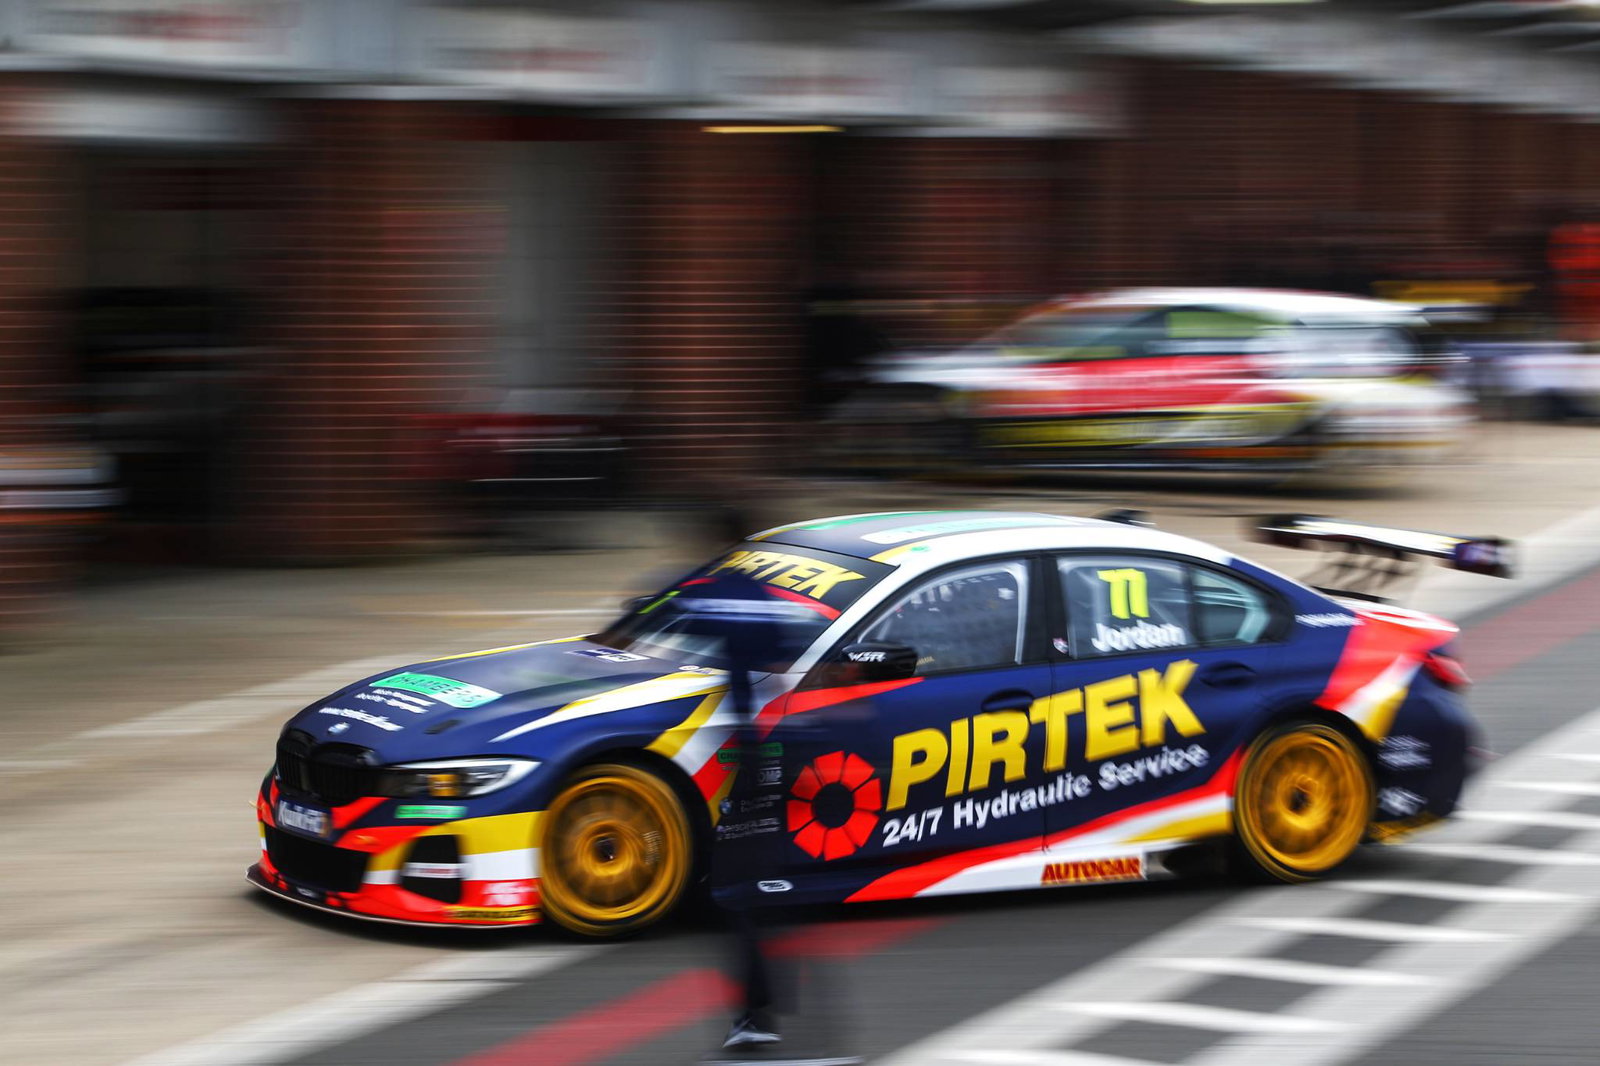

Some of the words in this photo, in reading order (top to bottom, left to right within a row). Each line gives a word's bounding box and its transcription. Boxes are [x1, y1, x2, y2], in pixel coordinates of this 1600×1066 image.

[705, 550, 867, 600] PIRTEK
[1091, 619, 1187, 652] Jordan
[886, 659, 1206, 812] PIRTEK
[883, 806, 943, 847] 24/7
[953, 771, 1093, 829] Hydraulic
[1099, 743, 1211, 791] Service
[1041, 857, 1141, 884] AUTOCAR
